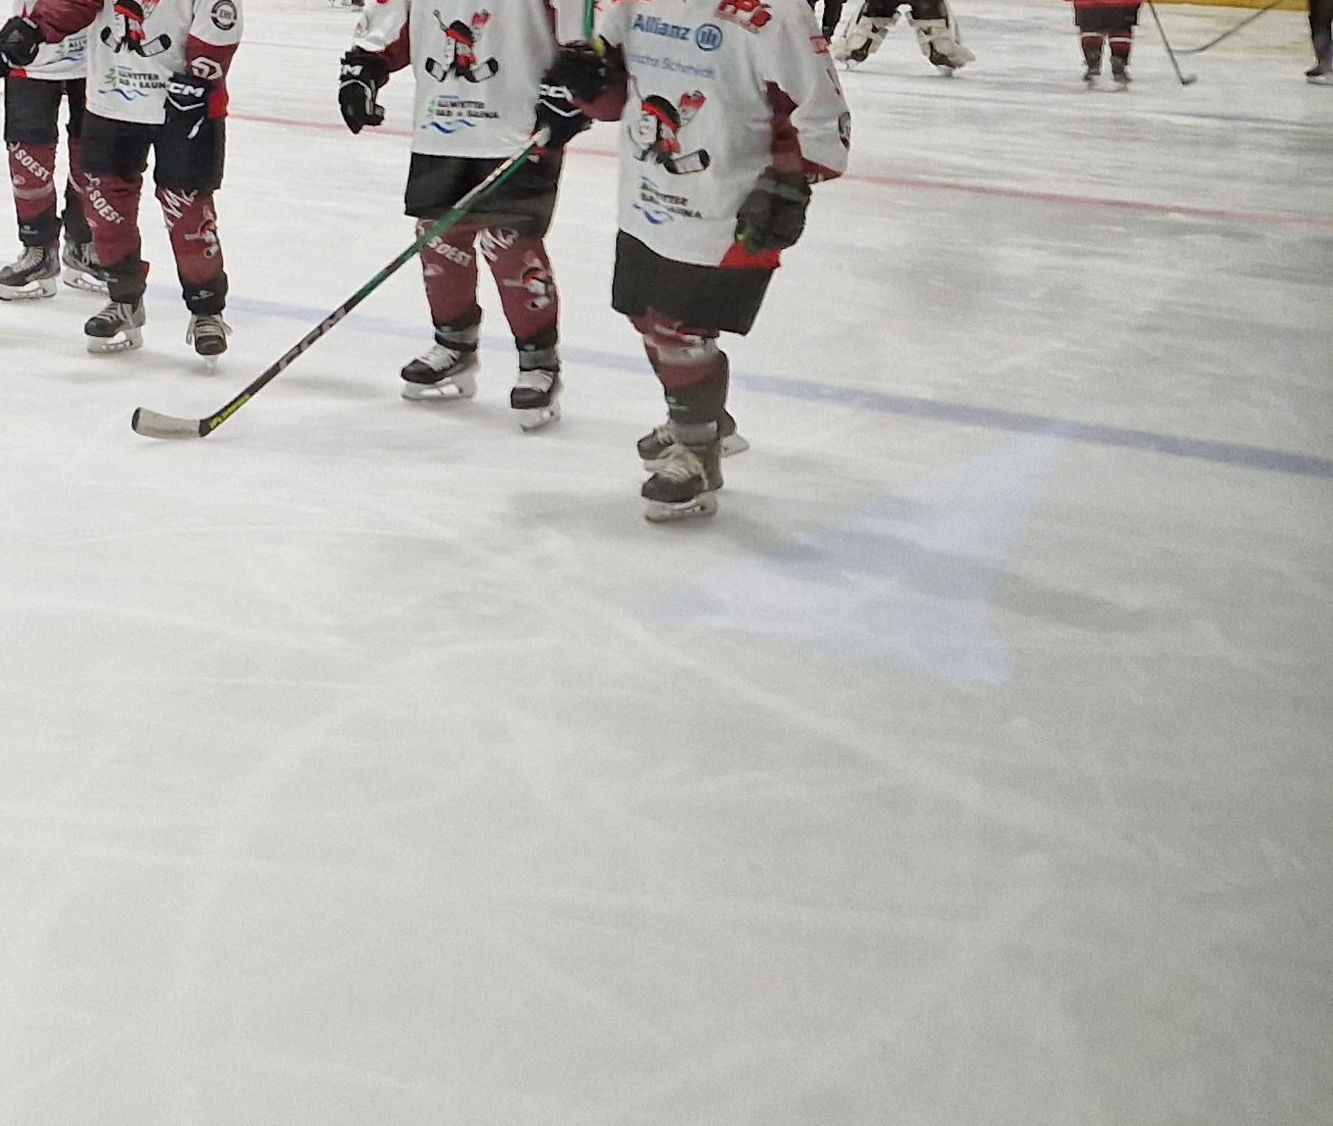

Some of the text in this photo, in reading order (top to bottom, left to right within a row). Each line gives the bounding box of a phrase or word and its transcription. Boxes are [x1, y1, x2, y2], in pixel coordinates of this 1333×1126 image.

[633, 13, 691, 41] Allianz
[14, 148, 51, 182] SOEST
[90, 189, 125, 224] SOEST
[427, 235, 473, 268] SOEST
